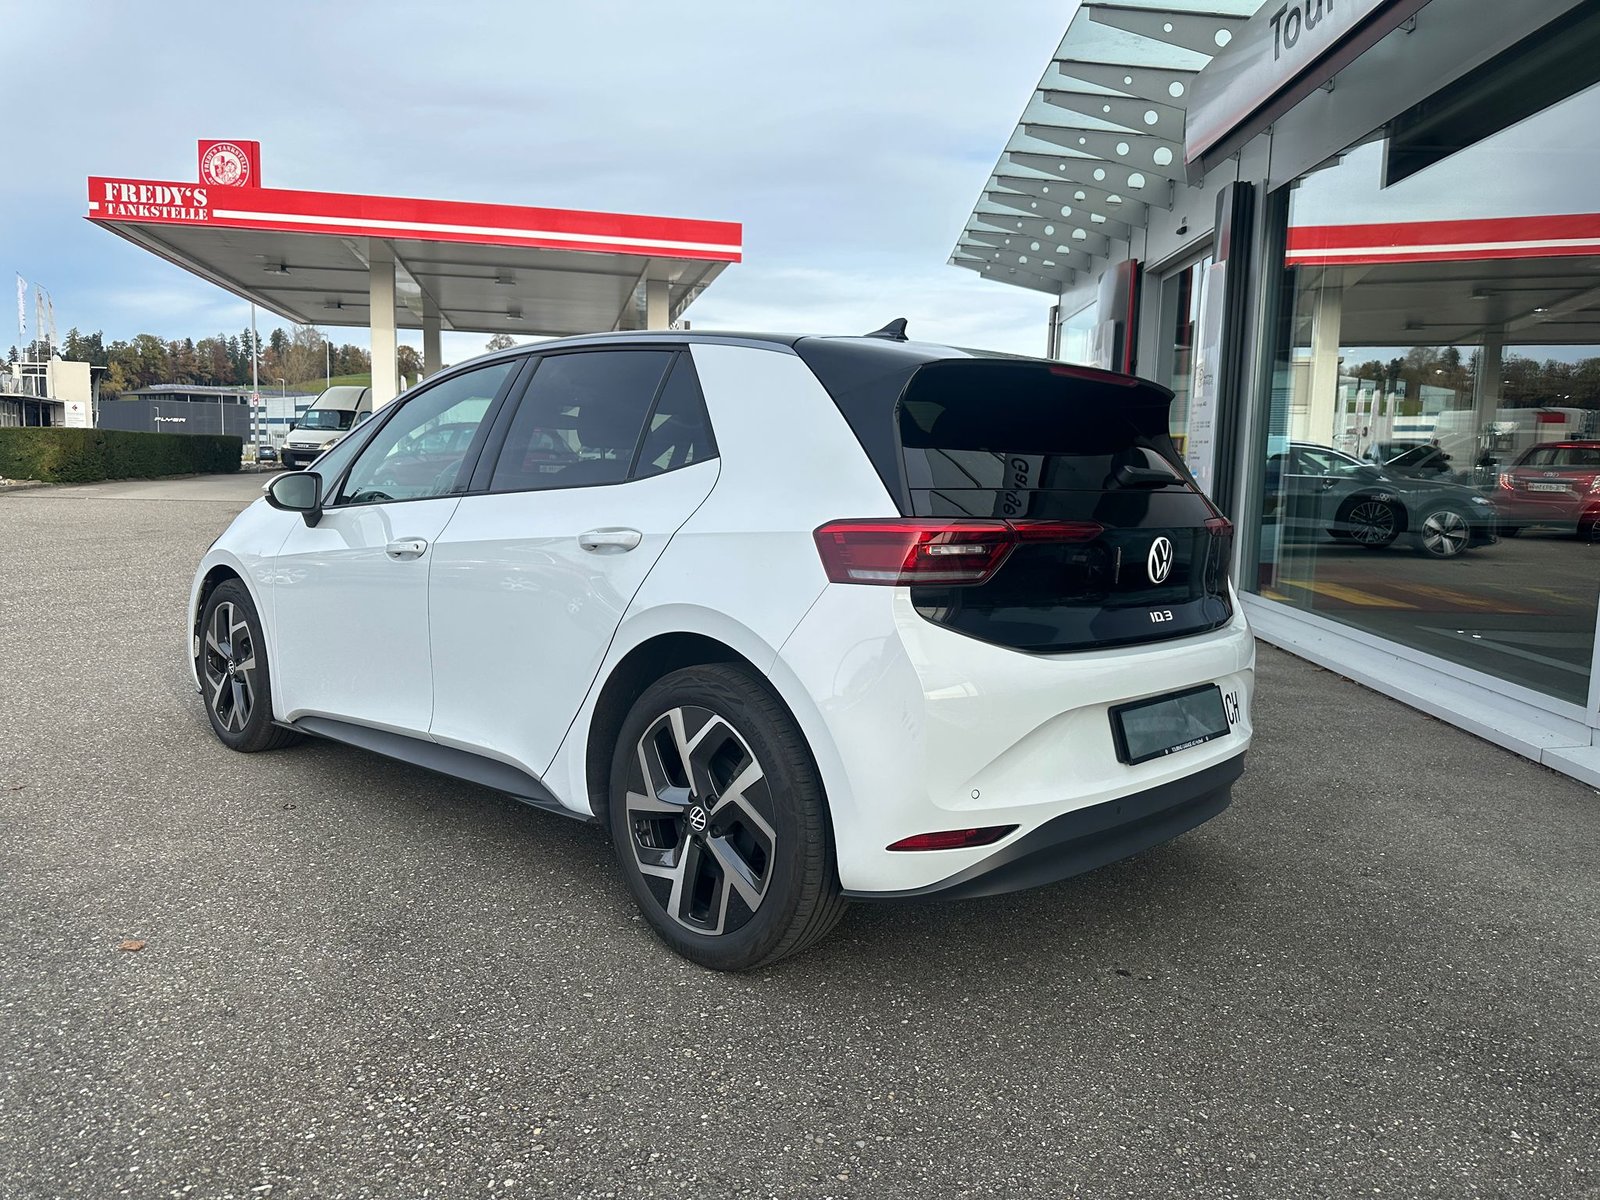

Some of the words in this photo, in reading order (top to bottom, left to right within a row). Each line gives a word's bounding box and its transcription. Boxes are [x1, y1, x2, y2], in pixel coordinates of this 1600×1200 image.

[1269, 0, 1334, 61] Tou
[105, 182, 207, 206] FREDY'S
[106, 203, 208, 220] TANKSTELLE
[1225, 691, 1240, 724] CH
